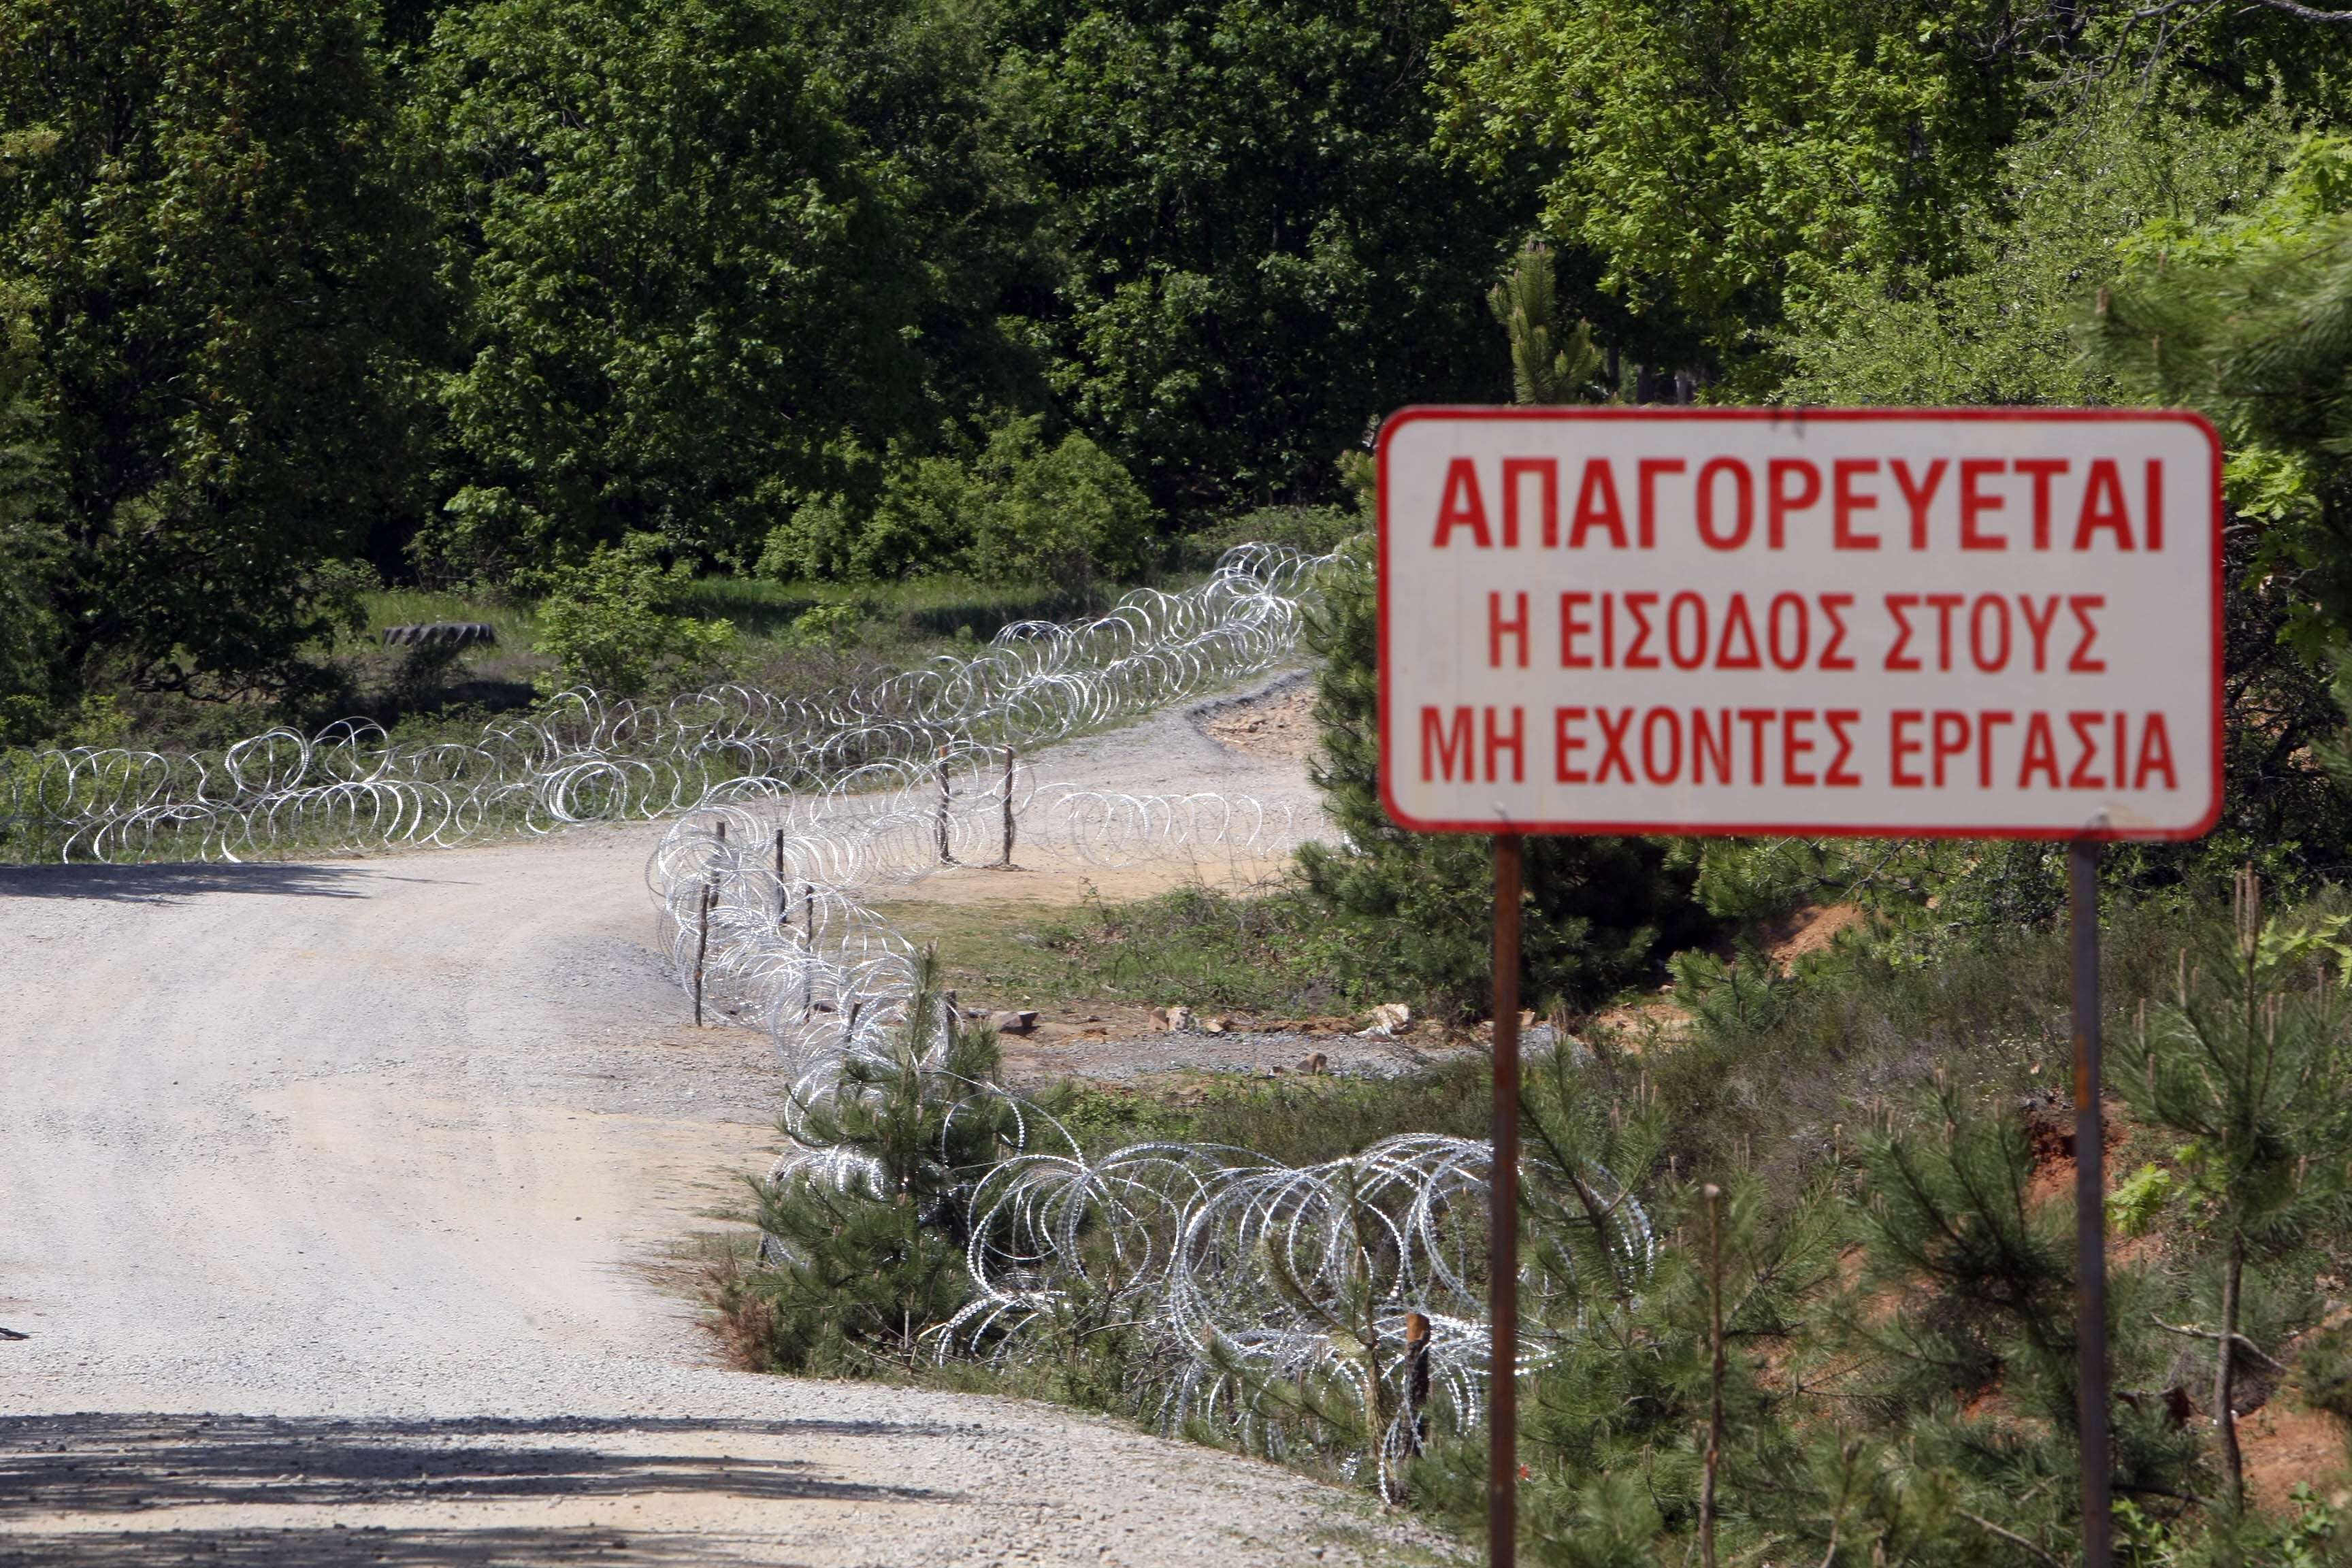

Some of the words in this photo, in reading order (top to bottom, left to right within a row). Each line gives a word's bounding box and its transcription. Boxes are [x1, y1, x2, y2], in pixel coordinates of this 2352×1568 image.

[1432, 455, 2164, 551] ΑΠΑΓΟΡΕΥΕΤΑΙ
[1488, 591, 1530, 669] Η
[1559, 590, 1857, 672] ΕΙΣΟΔΟΣ
[1884, 593, 2106, 674] ΣΤΟΥΣ
[1420, 704, 1525, 784] ΜΗ
[1554, 705, 1862, 787] ΕΧΟΝΤΕΣ
[1890, 708, 2178, 791] ΕΡΓΑΣΙΑ
